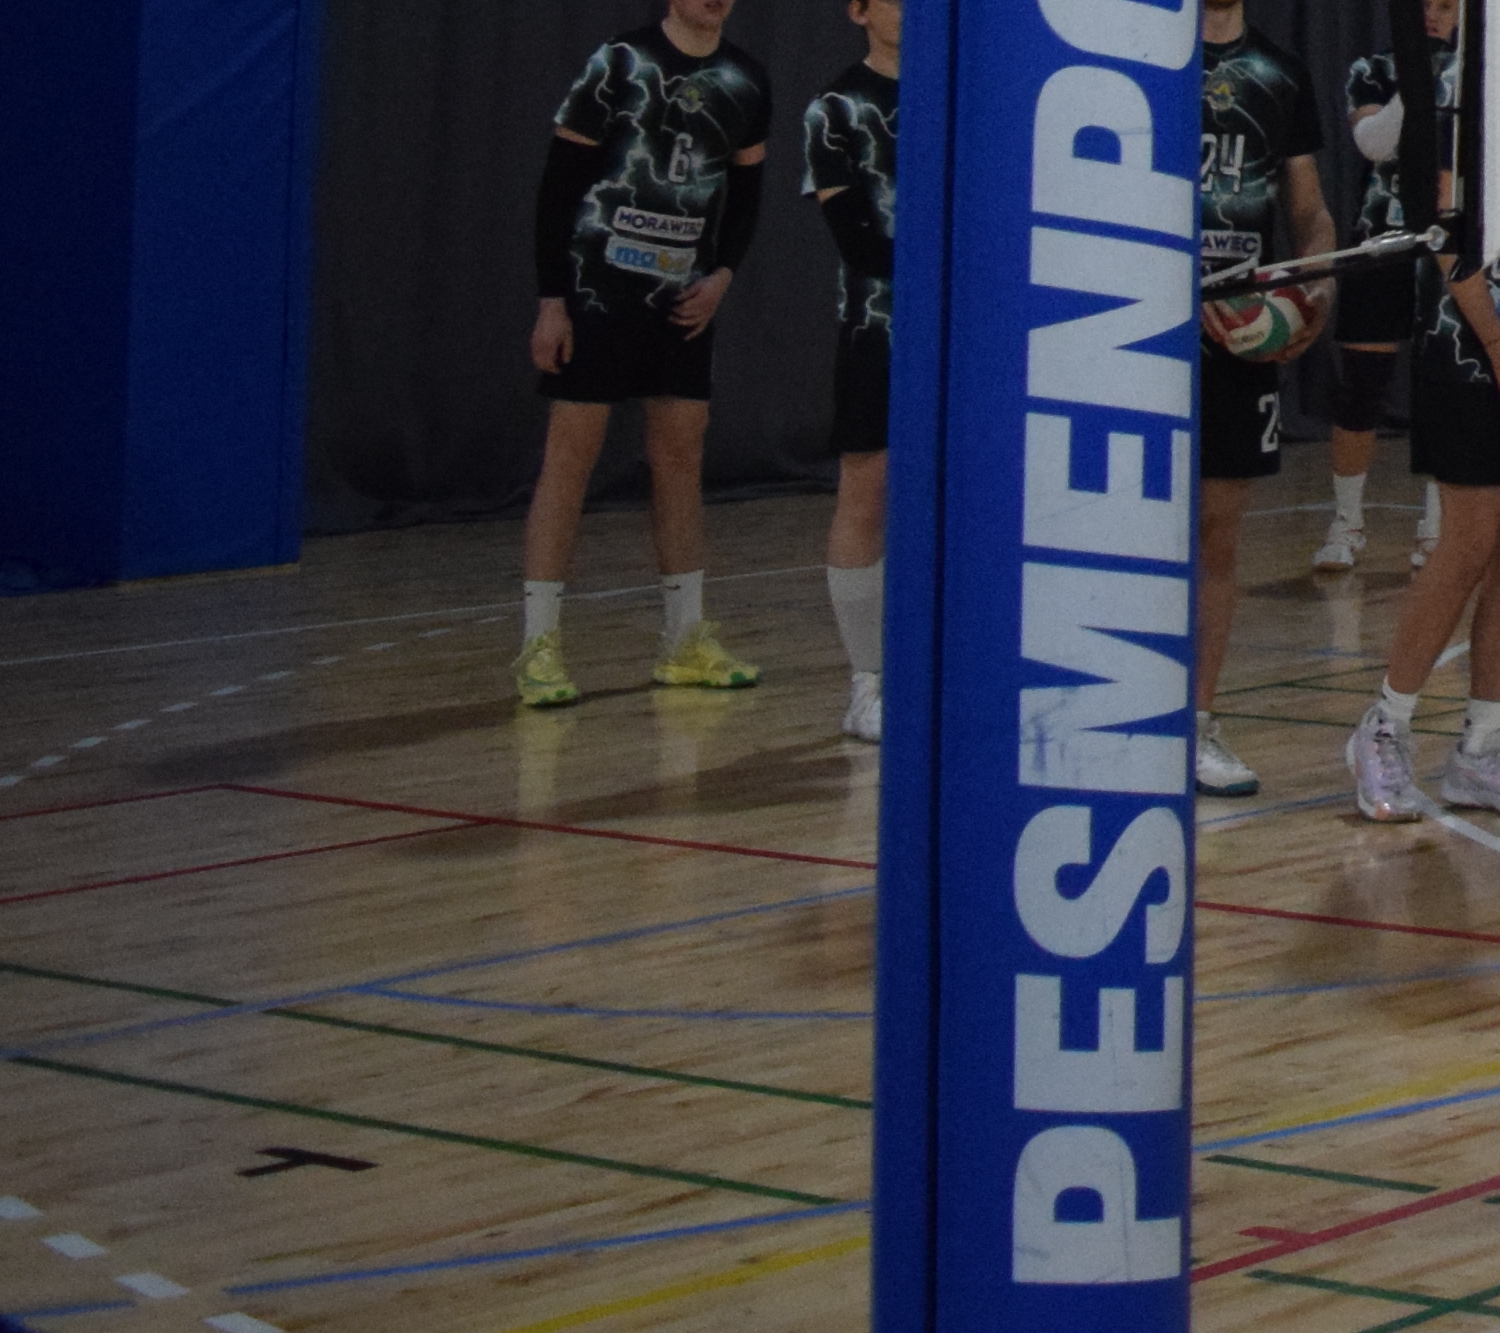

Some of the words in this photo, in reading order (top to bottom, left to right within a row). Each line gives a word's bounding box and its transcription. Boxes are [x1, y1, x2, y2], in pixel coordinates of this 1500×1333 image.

[668, 132, 694, 184] 6
[1200, 134, 1245, 194] 24
[1257, 391, 1281, 454] 2
